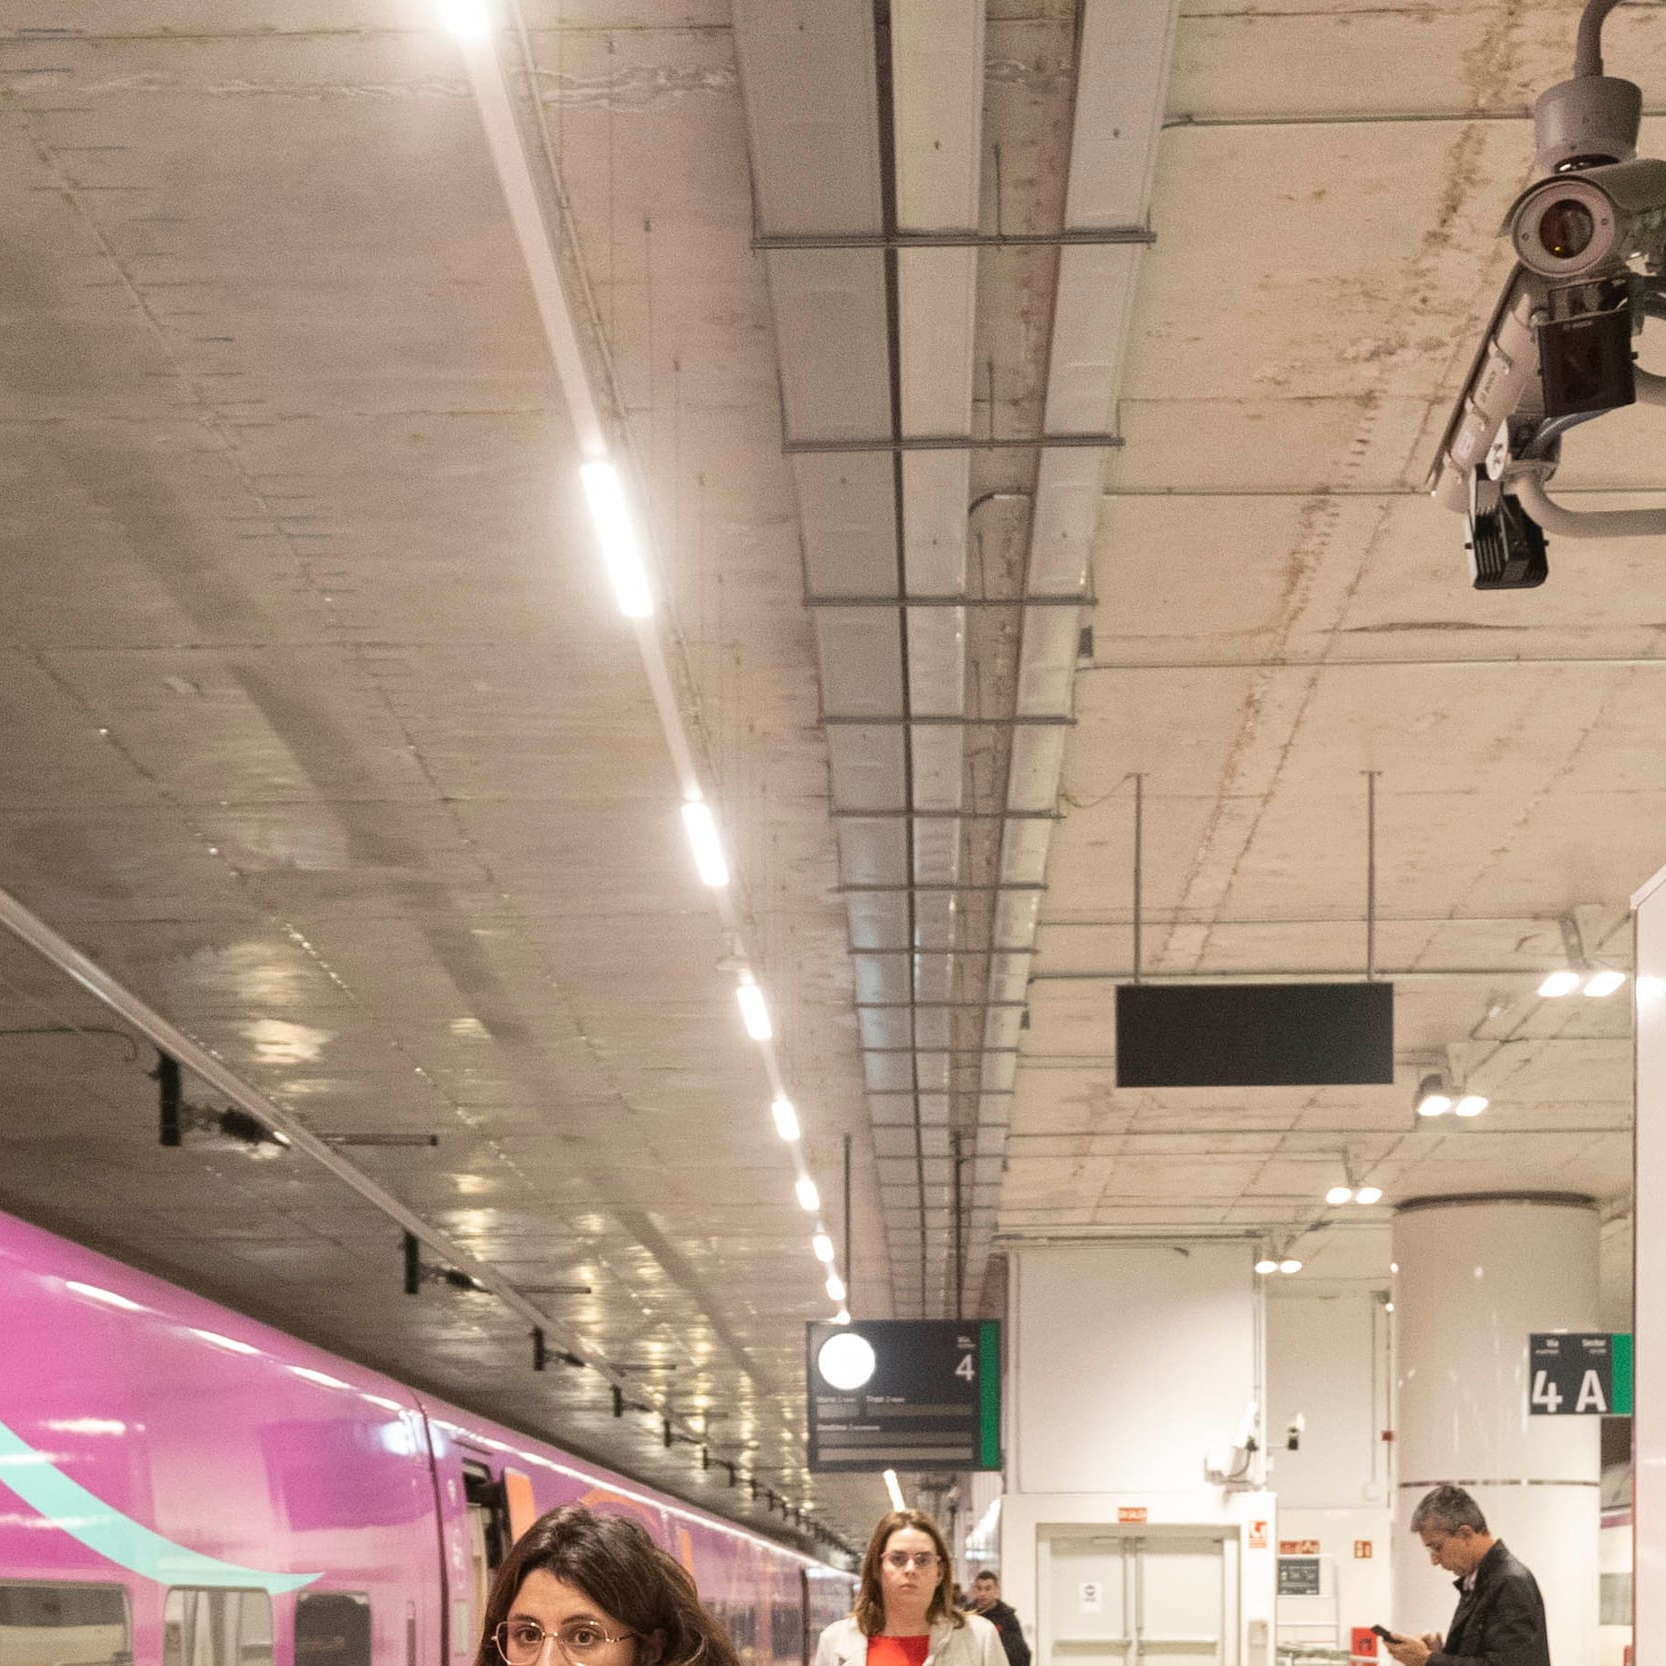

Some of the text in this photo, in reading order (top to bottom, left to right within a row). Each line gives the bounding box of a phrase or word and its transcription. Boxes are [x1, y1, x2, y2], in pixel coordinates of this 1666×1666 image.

[955, 1354, 976, 1381] 4
[1532, 1369, 1607, 1413] 4 A
